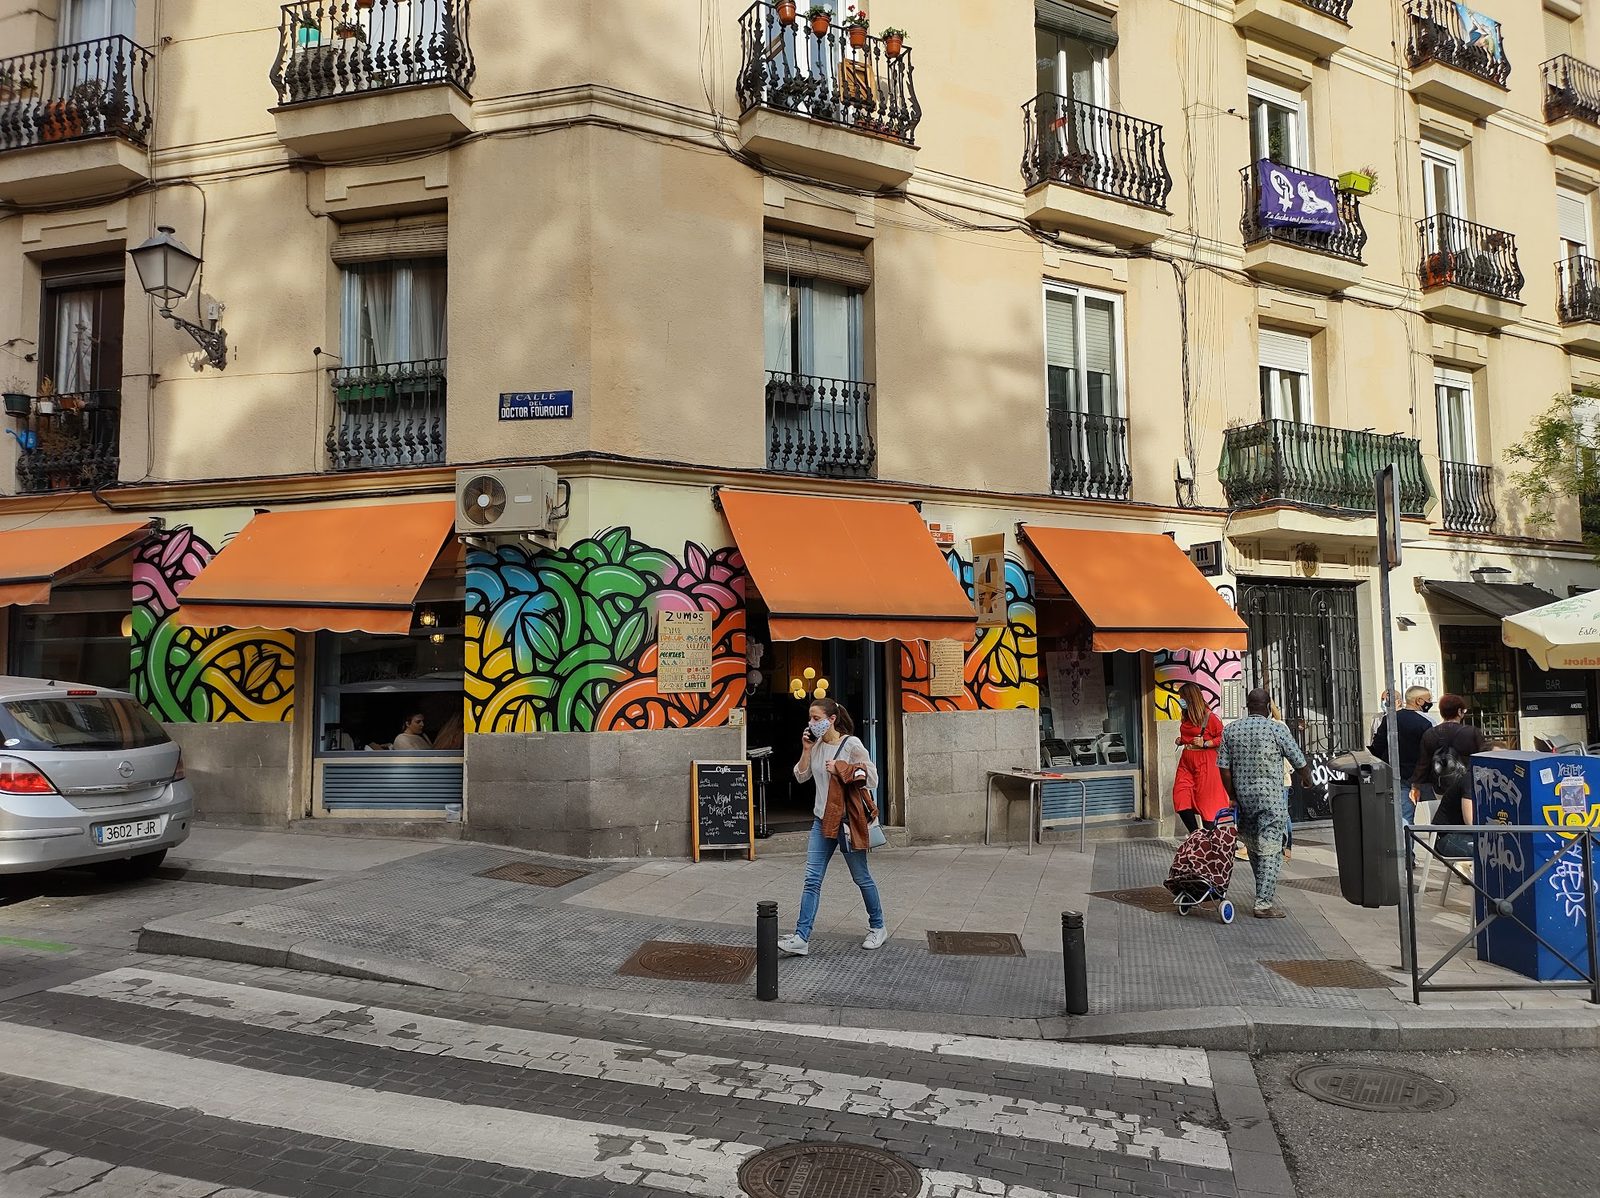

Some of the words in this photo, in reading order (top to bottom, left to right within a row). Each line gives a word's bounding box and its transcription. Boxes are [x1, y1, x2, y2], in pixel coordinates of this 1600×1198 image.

[516, 393, 556, 401] CALLE
[501, 406, 529, 418] DOCTOR
[530, 405, 569, 417] FOURQUET
[665, 611, 704, 622] ZUMOS
[1578, 626, 1597, 636] Este
[1545, 679, 1561, 690] BAR
[106, 825, 132, 840] 3602
[136, 821, 156, 835] FJR
